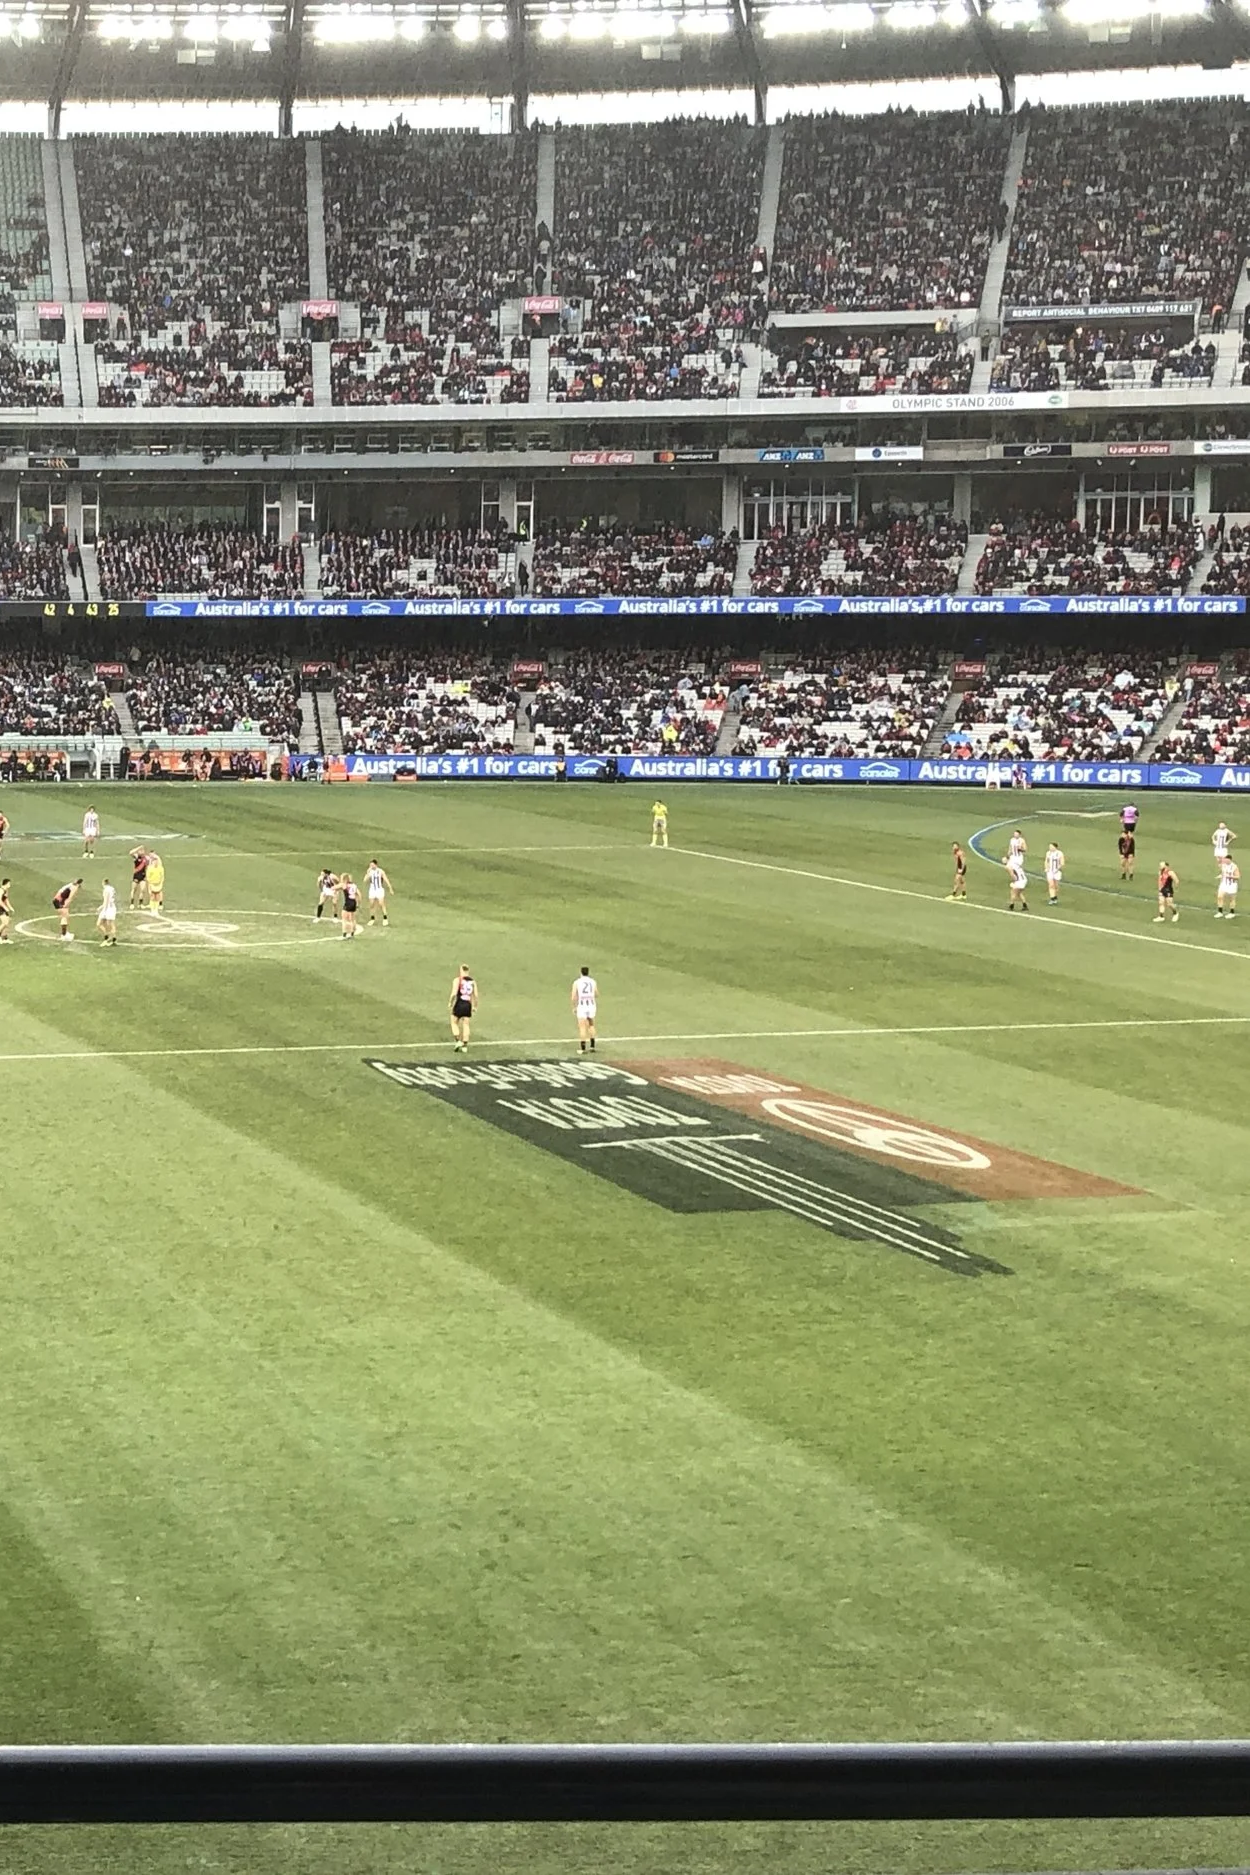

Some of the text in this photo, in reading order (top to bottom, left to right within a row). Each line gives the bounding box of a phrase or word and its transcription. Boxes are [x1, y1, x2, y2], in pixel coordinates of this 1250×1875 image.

[1012, 309, 1041, 317] REPORT
[1043, 308, 1085, 316] ANTISOCIAL
[1088, 306, 1131, 315] BEHAVIOUR
[892, 396, 1015, 409] OLYMPIC STAND 2006
[763, 452, 781, 461] ANZ
[796, 451, 814, 460] ANZ
[195, 602, 348, 616] Australia's #1 for cars
[404, 601, 560, 615] Australia's #1 for cars
[618, 600, 779, 614] Australia's #1 for cars
[923, 599, 941, 612] #1
[945, 599, 968, 612] for
[971, 601, 1005, 612] cars
[1066, 599, 1238, 613] Australia's #1 for cars
[457, 757, 479, 774] #1
[484, 757, 515, 774] for
[629, 759, 733, 777] Australia's
[738, 759, 762, 777] #1
[801, 763, 843, 778] cars
[1031, 764, 1056, 781] #1
[1062, 763, 1093, 782] for
[1097, 767, 1141, 784] cars
[657, 1073, 802, 1094] TOYOTA
[495, 1095, 712, 1130] TOYOTA
